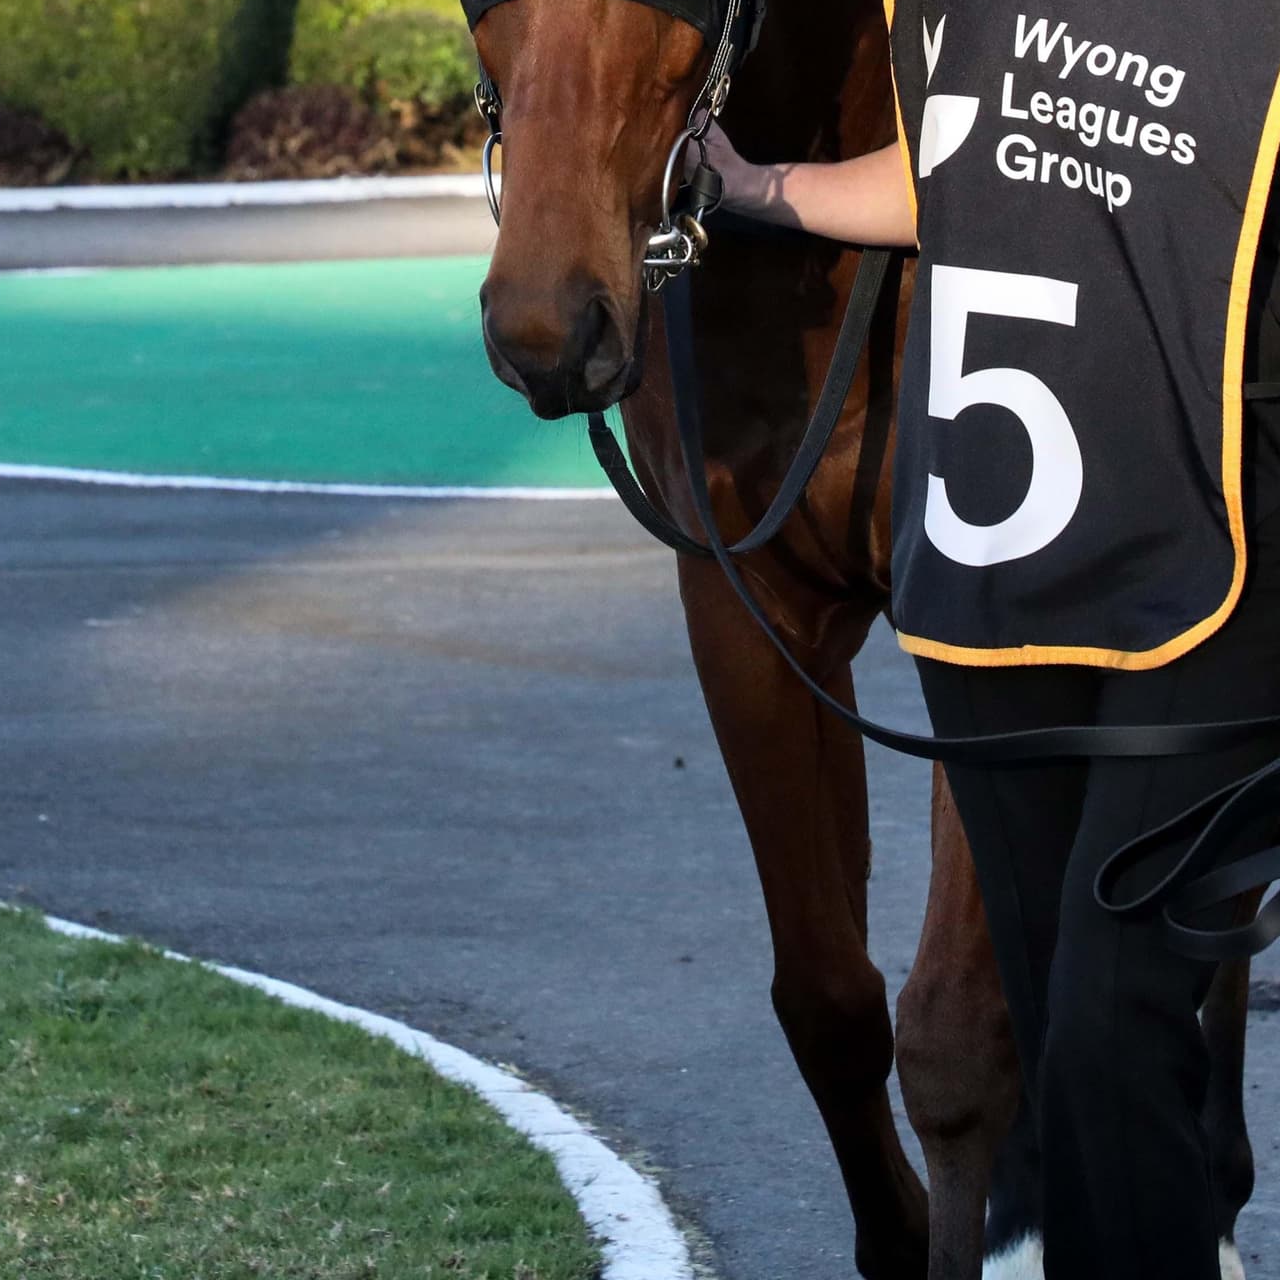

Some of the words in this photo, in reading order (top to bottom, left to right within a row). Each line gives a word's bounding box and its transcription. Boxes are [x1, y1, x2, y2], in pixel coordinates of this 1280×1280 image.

[1014, 14, 1186, 108] Wyong
[1000, 72, 1197, 166] Leagues
[995, 133, 1133, 213] Group
[924, 263, 1084, 568] 5
